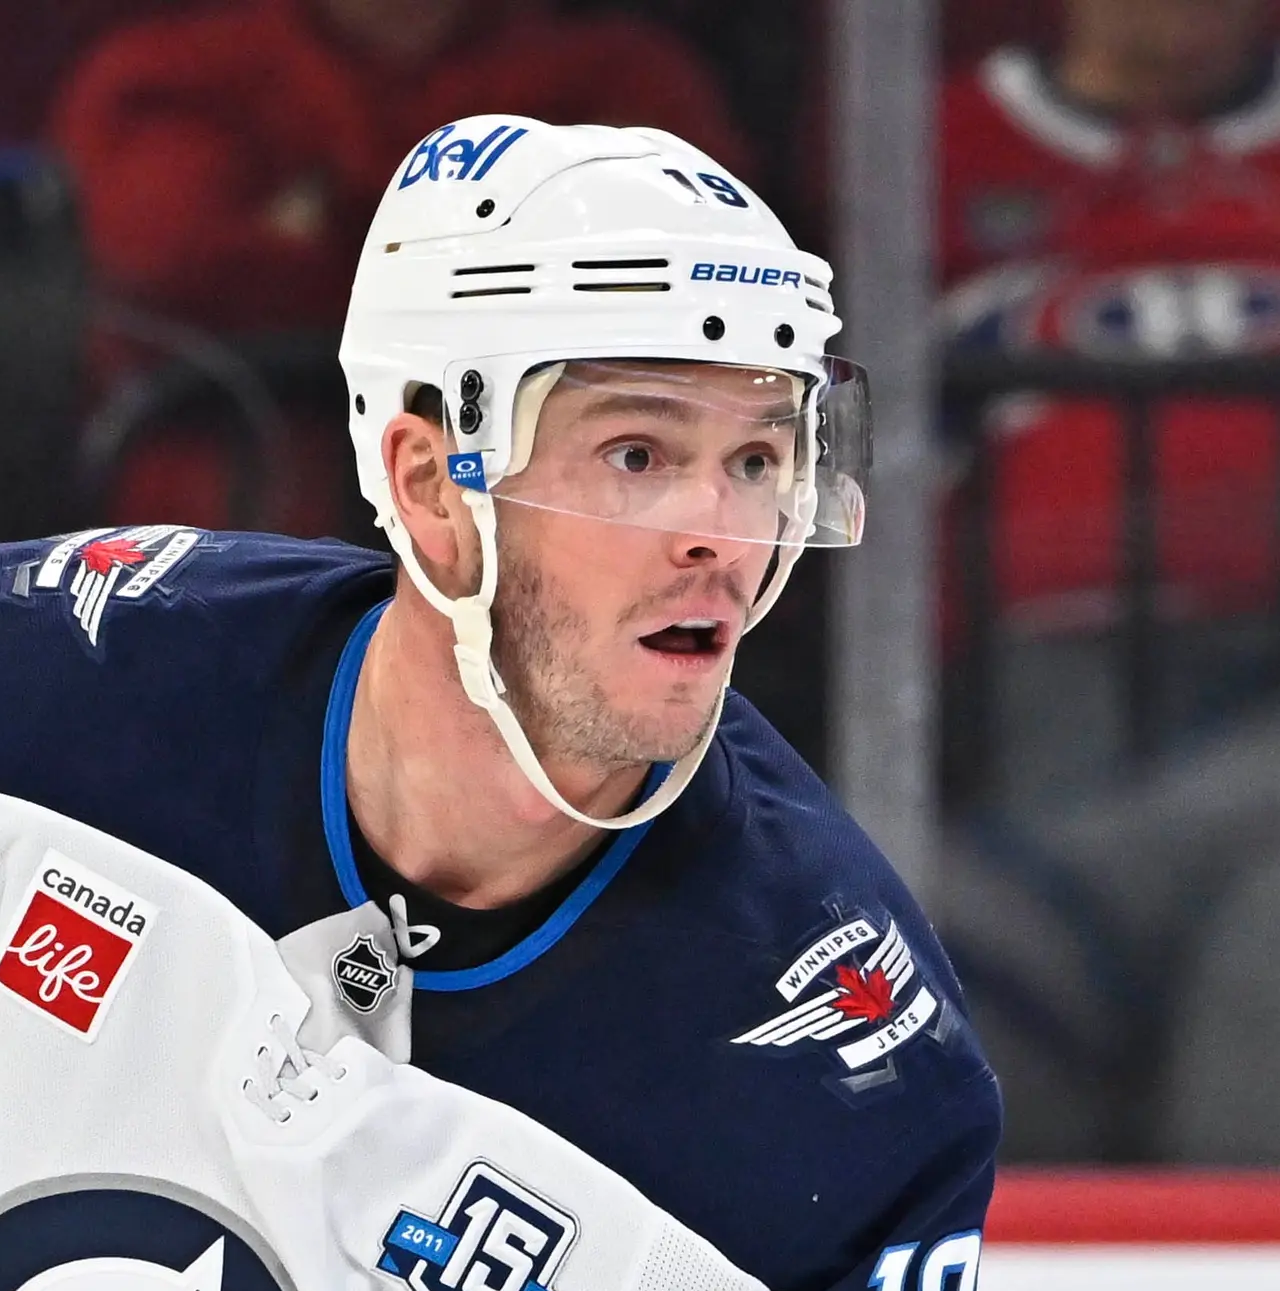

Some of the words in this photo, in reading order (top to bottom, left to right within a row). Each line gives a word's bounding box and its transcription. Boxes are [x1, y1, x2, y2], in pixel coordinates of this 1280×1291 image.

[398, 125, 529, 190] Bell
[662, 168, 749, 208] 19
[42, 868, 146, 937] canada
[5, 923, 104, 1003] life
[340, 965, 381, 989] NHL
[785, 925, 869, 991] WINNIPEG
[877, 1012, 919, 1050] JETS
[400, 1224, 443, 1252] 2011
